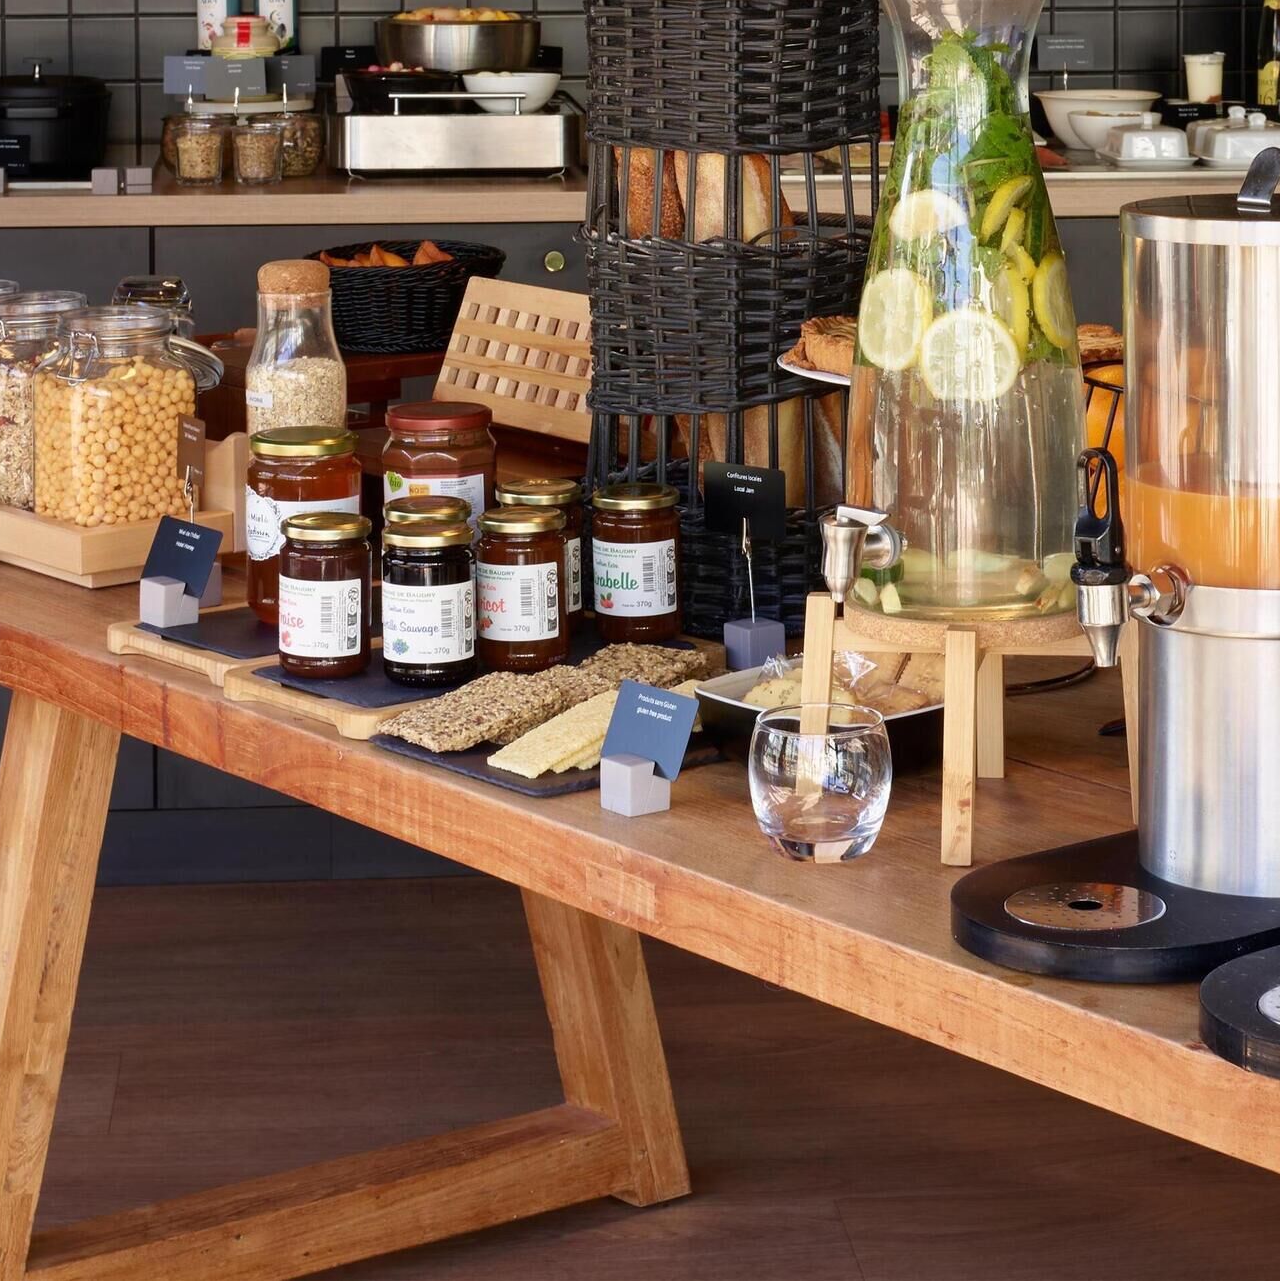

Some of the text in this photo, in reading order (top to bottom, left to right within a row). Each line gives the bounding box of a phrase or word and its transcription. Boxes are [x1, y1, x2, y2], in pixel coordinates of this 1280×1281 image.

[726, 471, 762, 482] Confitures locales
[636, 600, 652, 608] 370g
[399, 621, 439, 636] Sauvage
[514, 625, 530, 633] 370g
[313, 641, 329, 649] 370g
